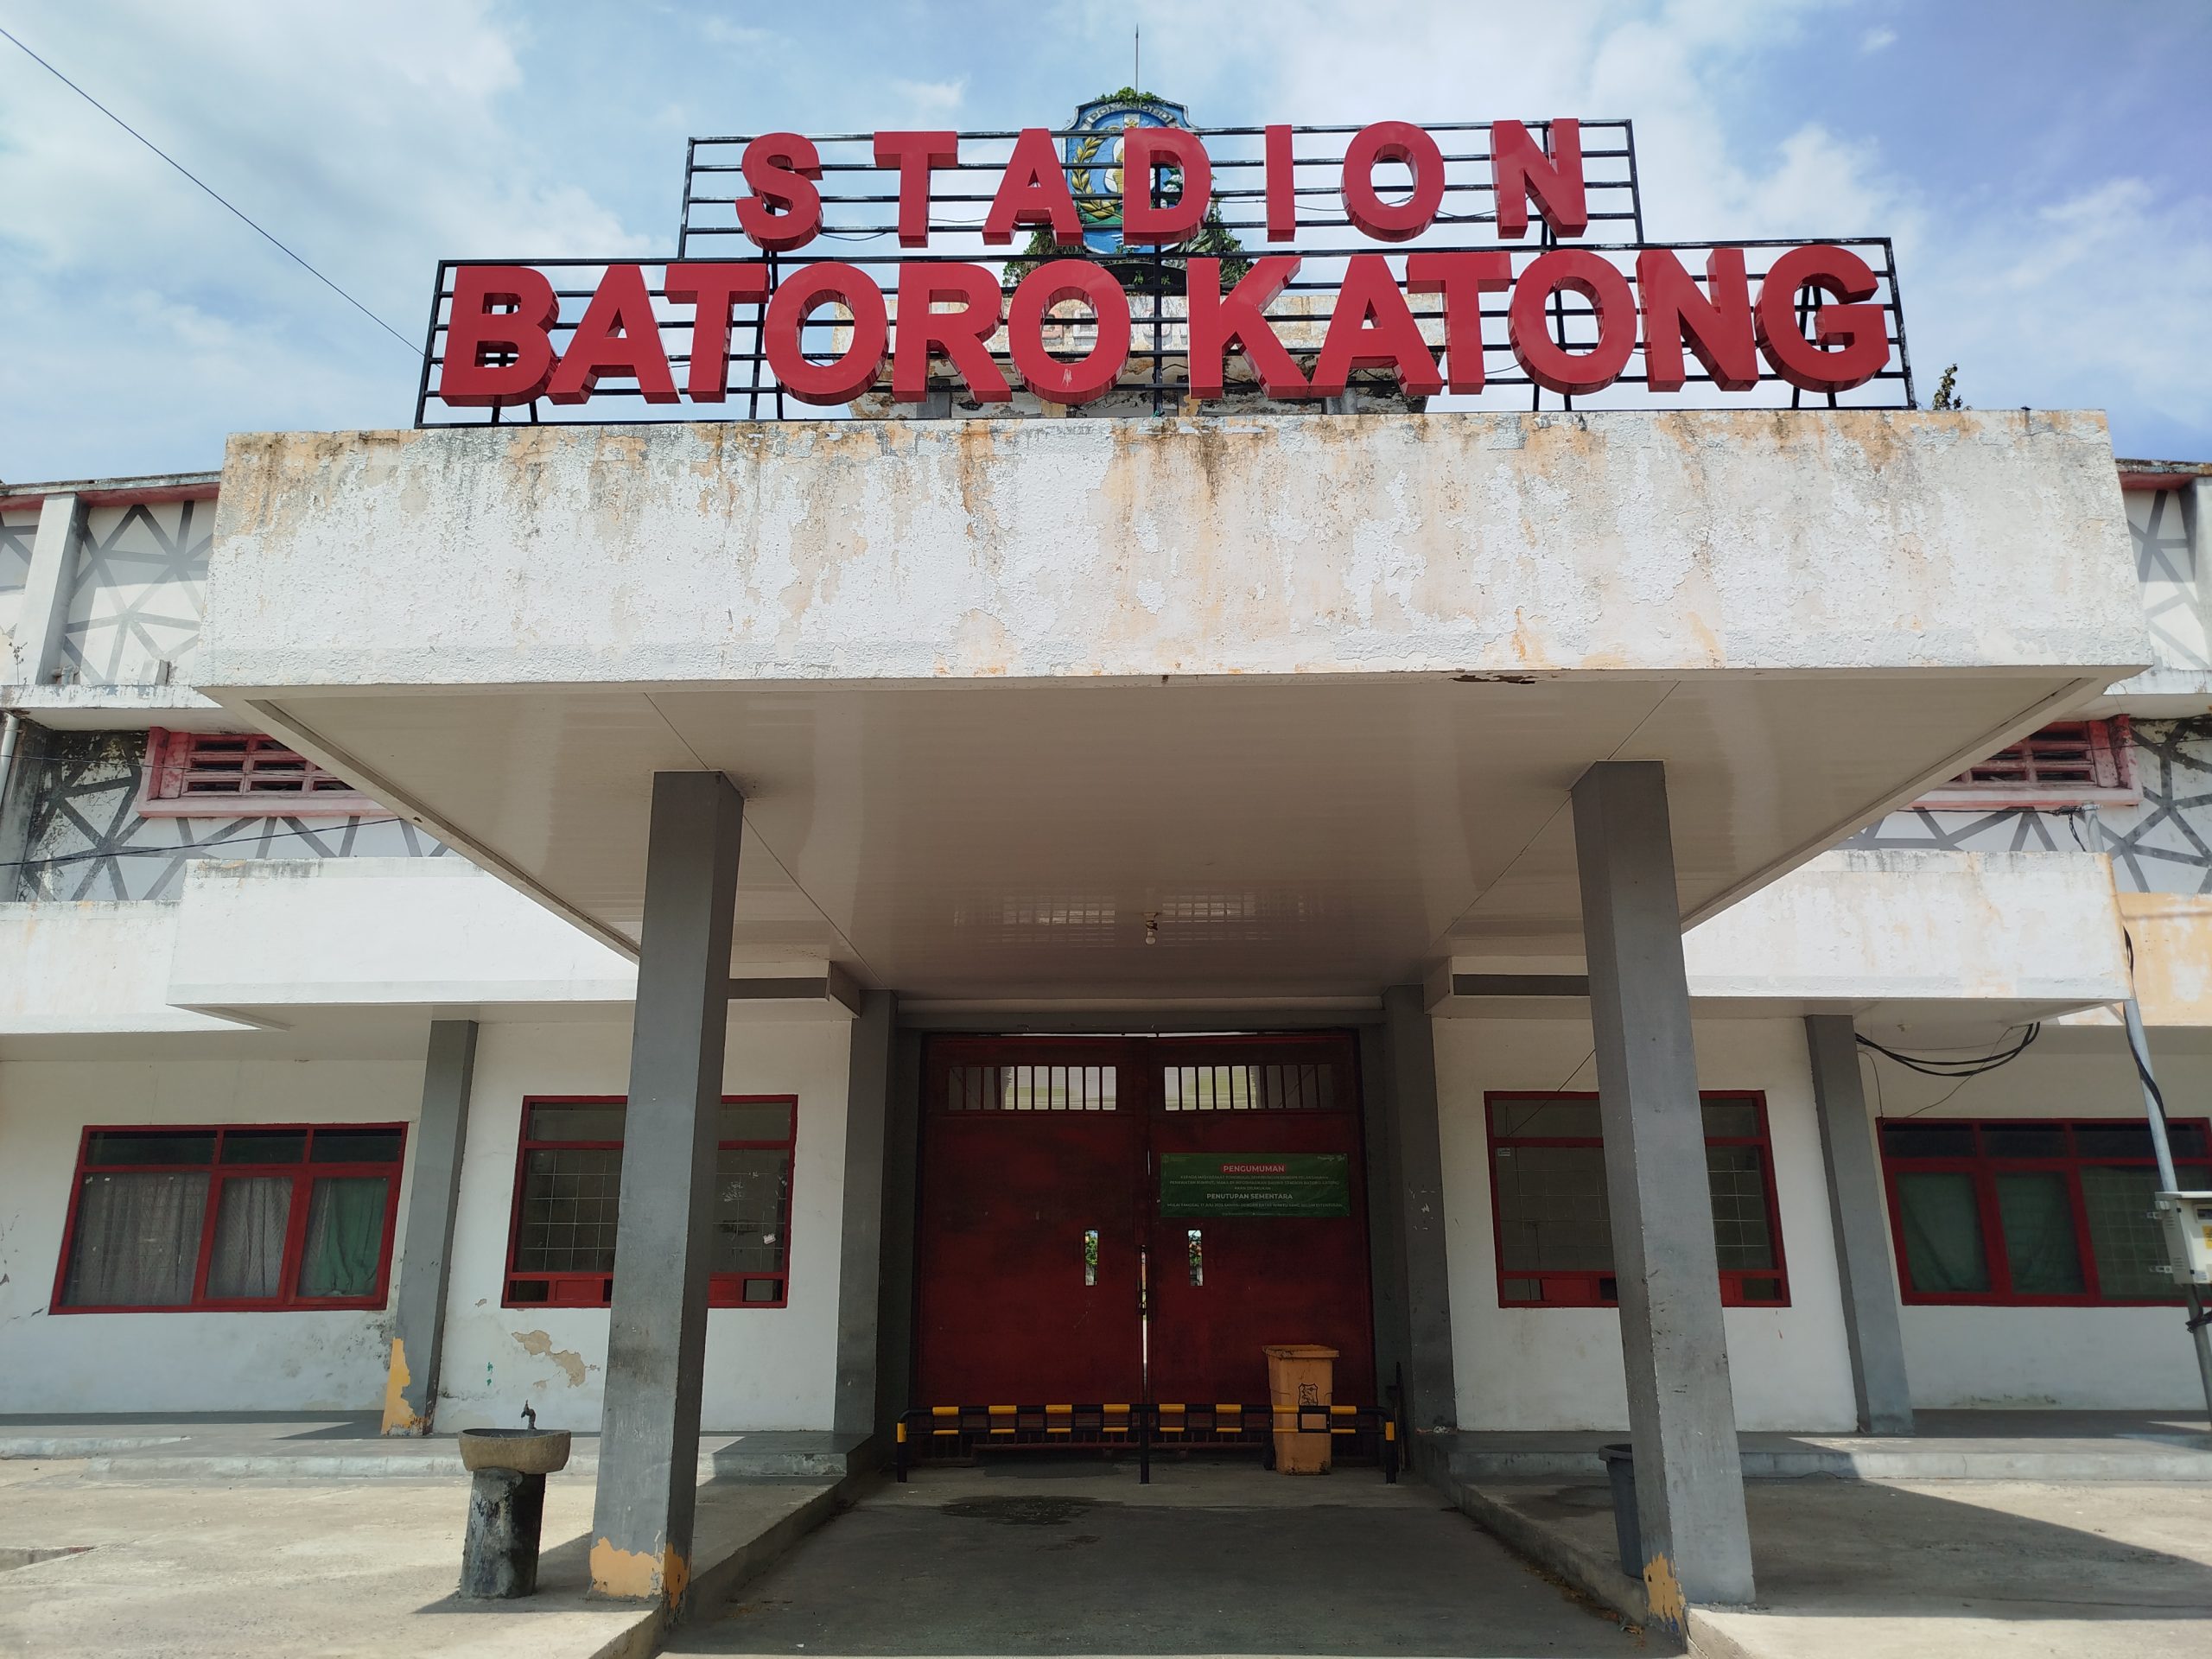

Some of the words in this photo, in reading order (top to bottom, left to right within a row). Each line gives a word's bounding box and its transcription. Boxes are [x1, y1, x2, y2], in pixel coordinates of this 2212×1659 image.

[734, 118, 1588, 252] STADION
[438, 258, 1132, 407] BATORO
[1188, 245, 1891, 400] KATONG
